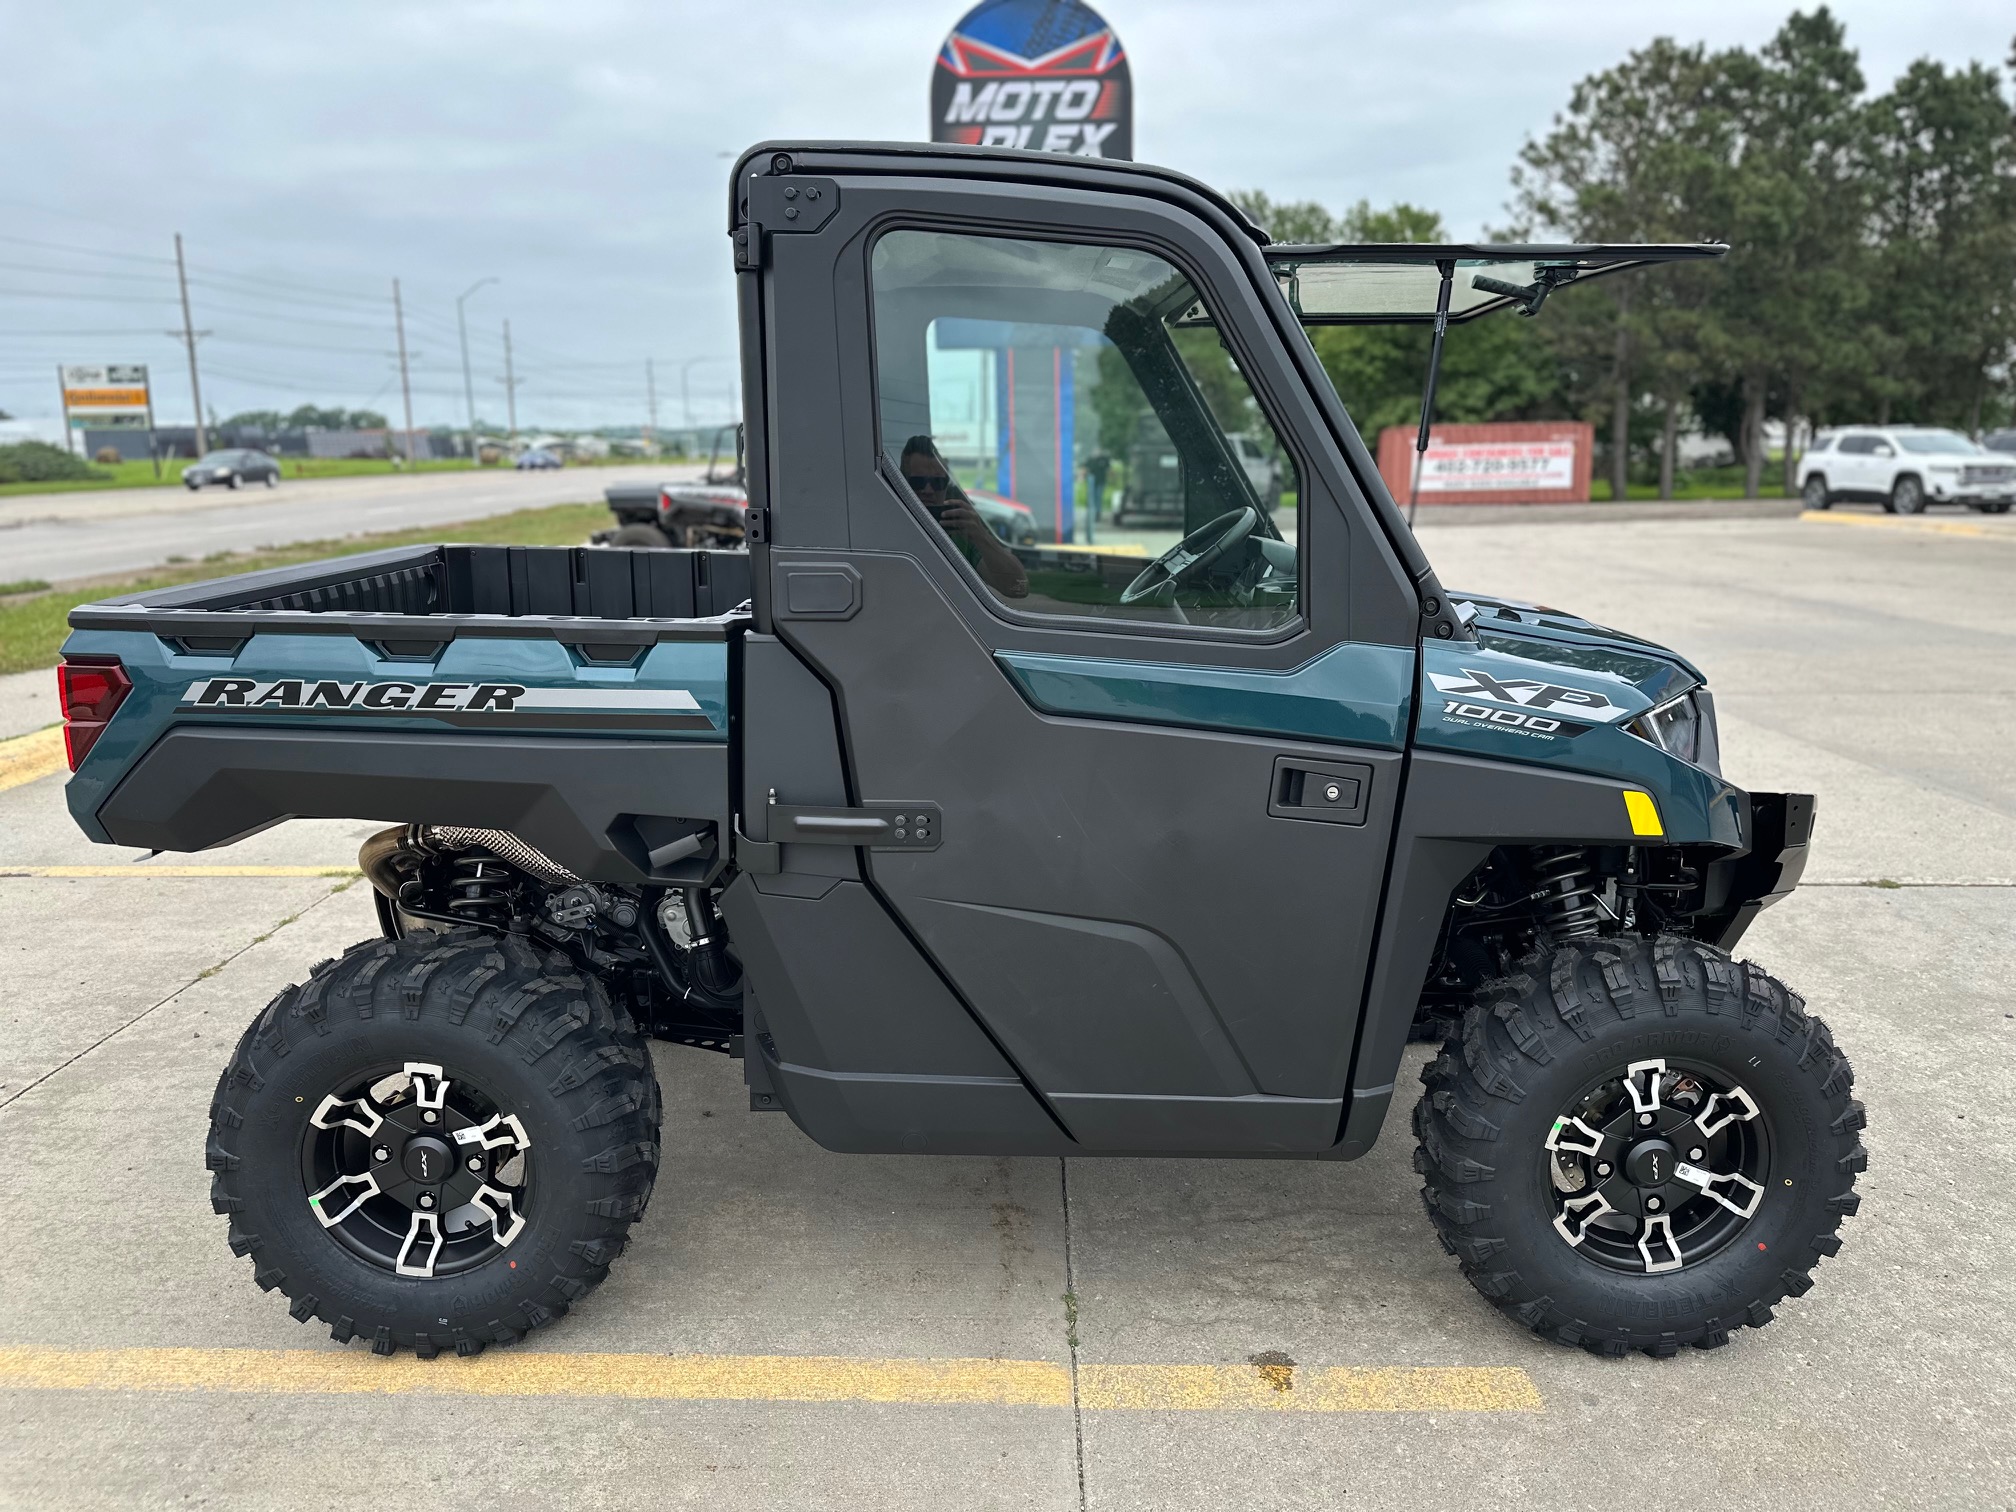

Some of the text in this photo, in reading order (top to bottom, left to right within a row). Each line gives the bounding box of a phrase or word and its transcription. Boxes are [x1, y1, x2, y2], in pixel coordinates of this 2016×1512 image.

[944, 79, 1101, 122] MOTO
[193, 678, 526, 712] RANGER
[1438, 667, 1615, 710] XP
[1442, 700, 1561, 733] 1000
[1442, 716, 1555, 741] DUAL OVERHEAD CAM
